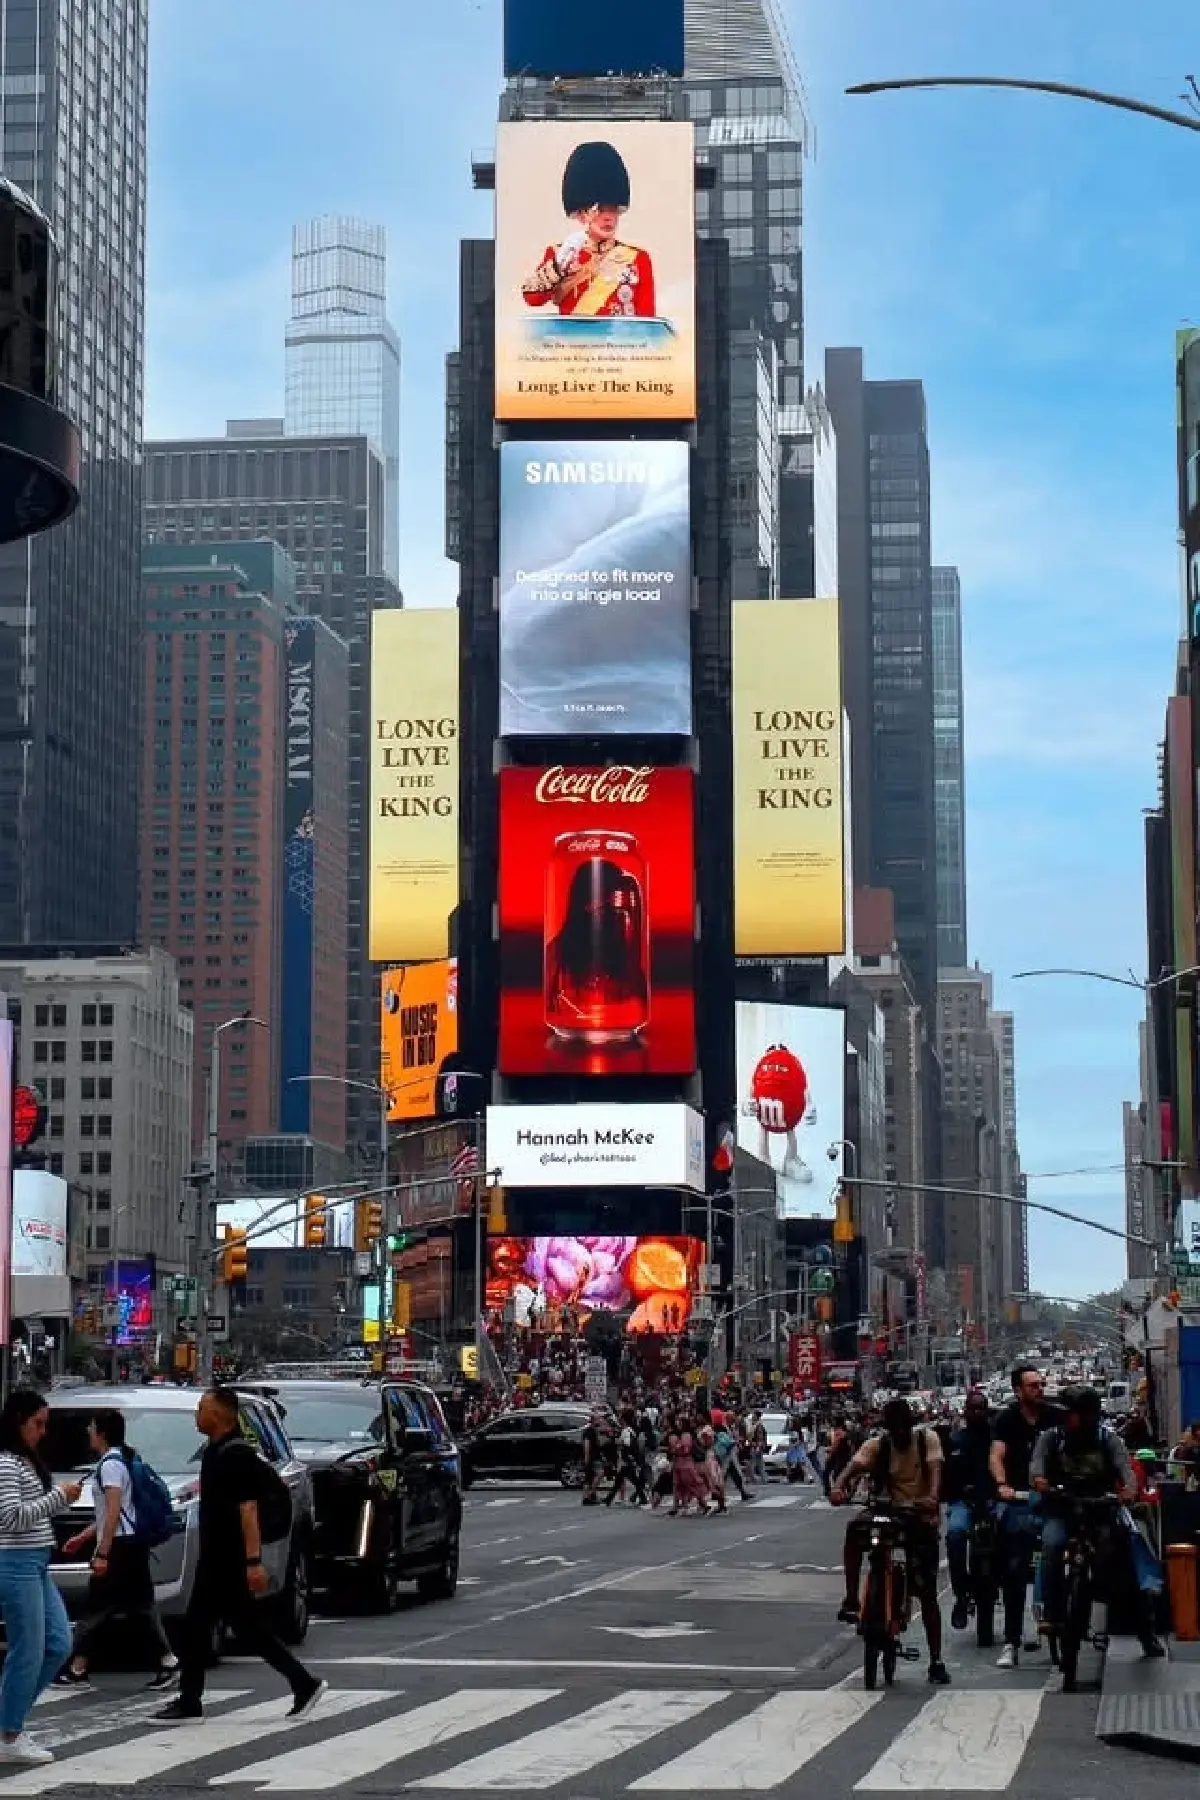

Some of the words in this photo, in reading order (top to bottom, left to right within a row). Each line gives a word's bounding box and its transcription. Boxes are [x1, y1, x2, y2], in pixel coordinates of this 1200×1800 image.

[517, 381, 559, 396] Long
[562, 381, 596, 393] Live
[600, 381, 630, 393] The
[636, 381, 673, 396] King
[525, 461, 664, 484] SAMSUN
[516, 570, 589, 587] Designed
[592, 571, 608, 582] to
[612, 568, 629, 582] fit
[631, 571, 674, 582] more
[531, 589, 560, 600] into
[562, 591, 572, 600] a
[576, 588, 621, 604] single
[626, 588, 661, 600] load
[376, 719, 457, 740] LONG
[753, 710, 835, 731] LONG
[381, 747, 450, 767] LIVE
[761, 738, 830, 759] LIVE
[396, 775, 435, 788] THE
[535, 764, 655, 803] Coca-Cola
[774, 768, 815, 780] THE
[379, 797, 453, 817] KING
[757, 788, 833, 808] KING
[401, 1002, 438, 1038] MUSIC
[516, 1128, 588, 1146] Hannah
[594, 1128, 655, 1146] McKee
